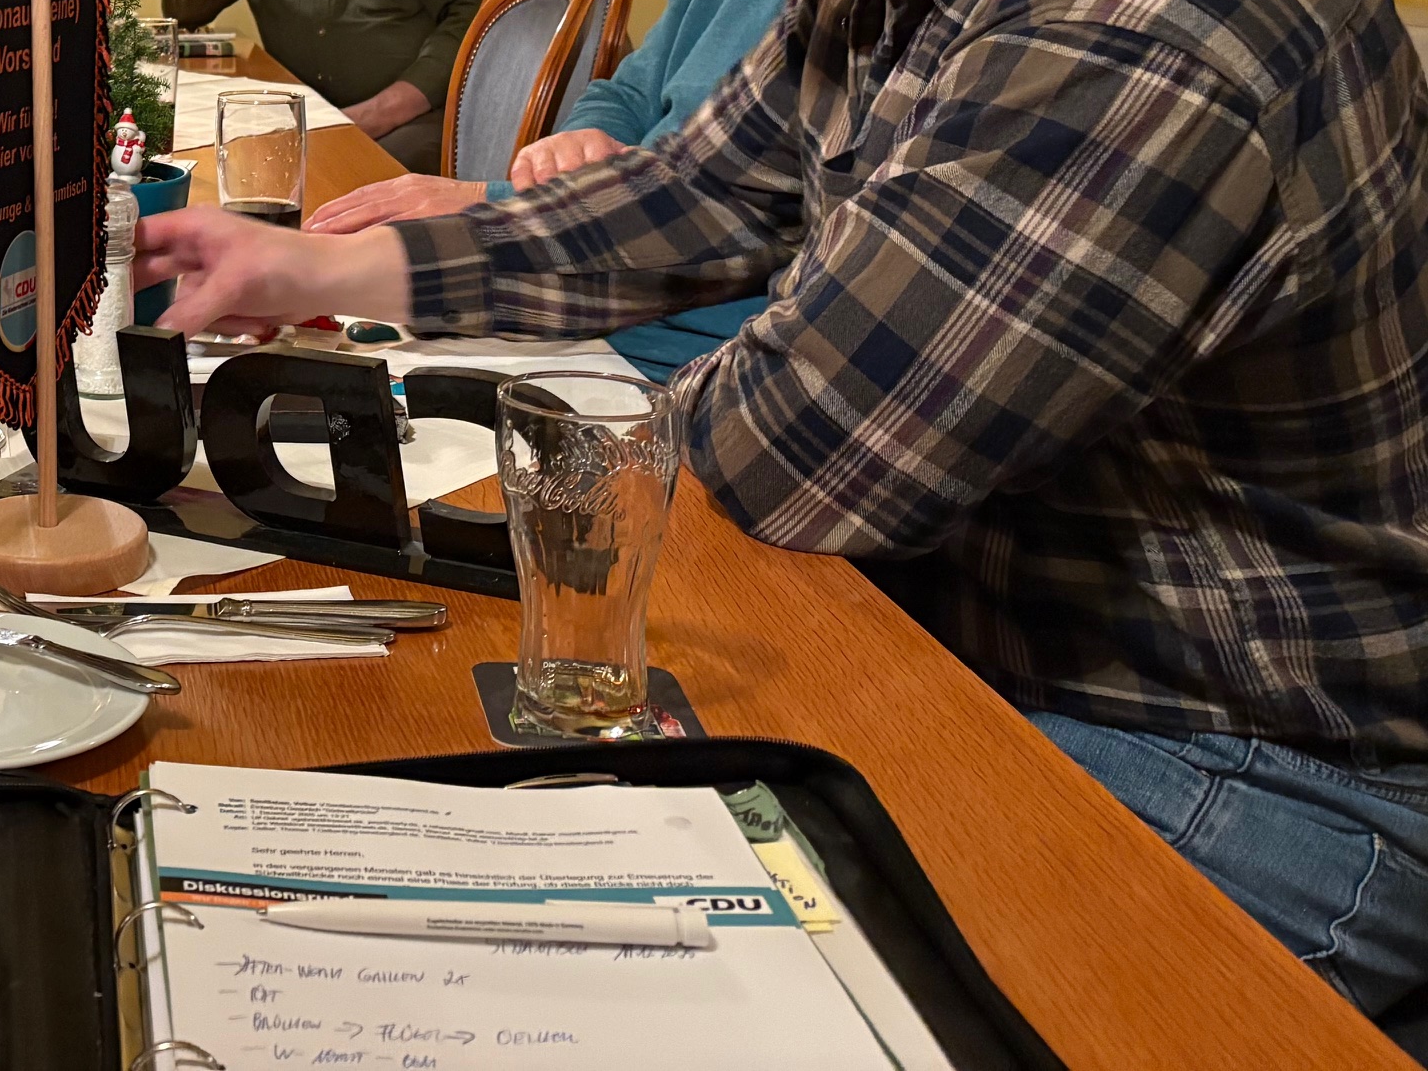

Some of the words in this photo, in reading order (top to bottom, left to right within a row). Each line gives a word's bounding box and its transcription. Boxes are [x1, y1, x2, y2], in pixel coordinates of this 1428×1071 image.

[15, 276, 36, 299] CDU
[251, 846, 277, 854] Sehr
[279, 848, 321, 857] geehrte
[324, 849, 365, 858] Herren,
[289, 865, 361, 873] vergangenen
[364, 866, 413, 876] Monaten
[414, 869, 436, 877] gab
[455, 871, 516, 880] hinsichtlich
[626, 873, 694, 881] Erneuerung
[337, 873, 364, 881] noch
[367, 875, 404, 883] einmal
